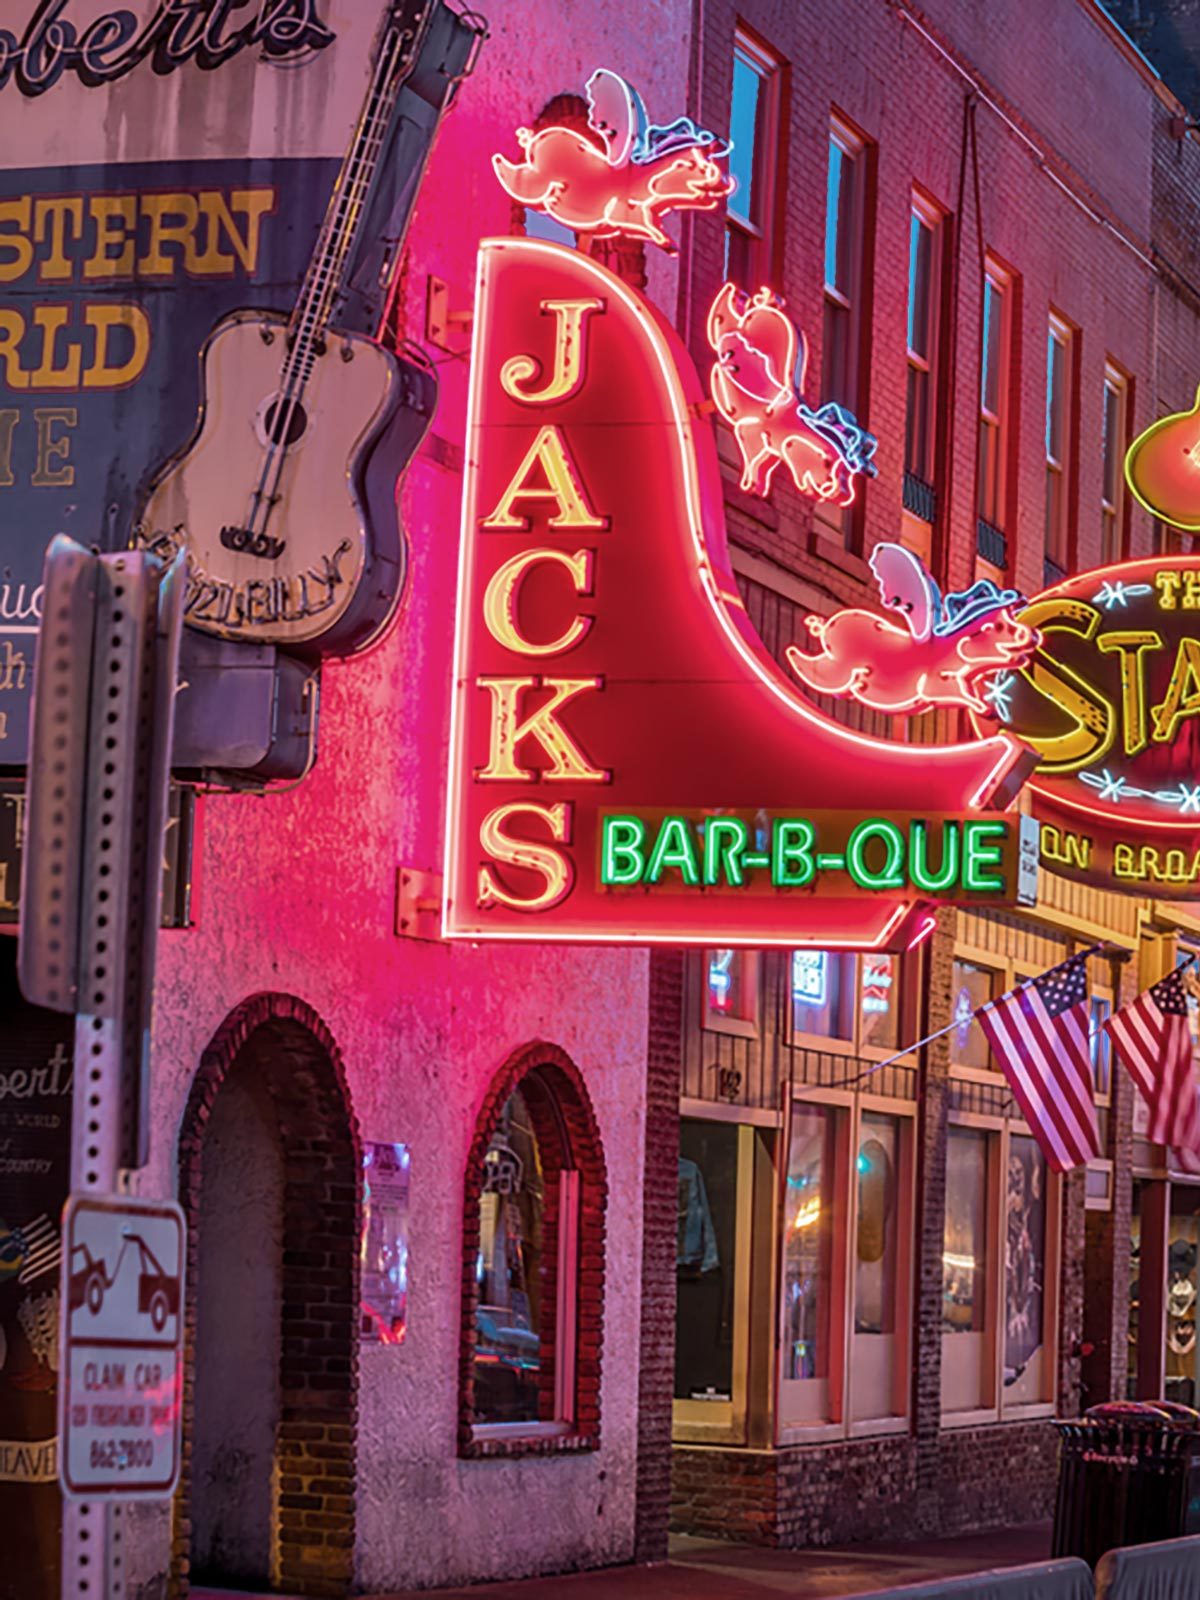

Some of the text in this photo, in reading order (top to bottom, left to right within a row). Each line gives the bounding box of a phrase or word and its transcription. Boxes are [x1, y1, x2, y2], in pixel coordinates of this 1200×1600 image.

[475, 299, 611, 911] JACKS
[601, 814, 1004, 890] BAR-B-QUE
[1040, 825, 1092, 870] ON
